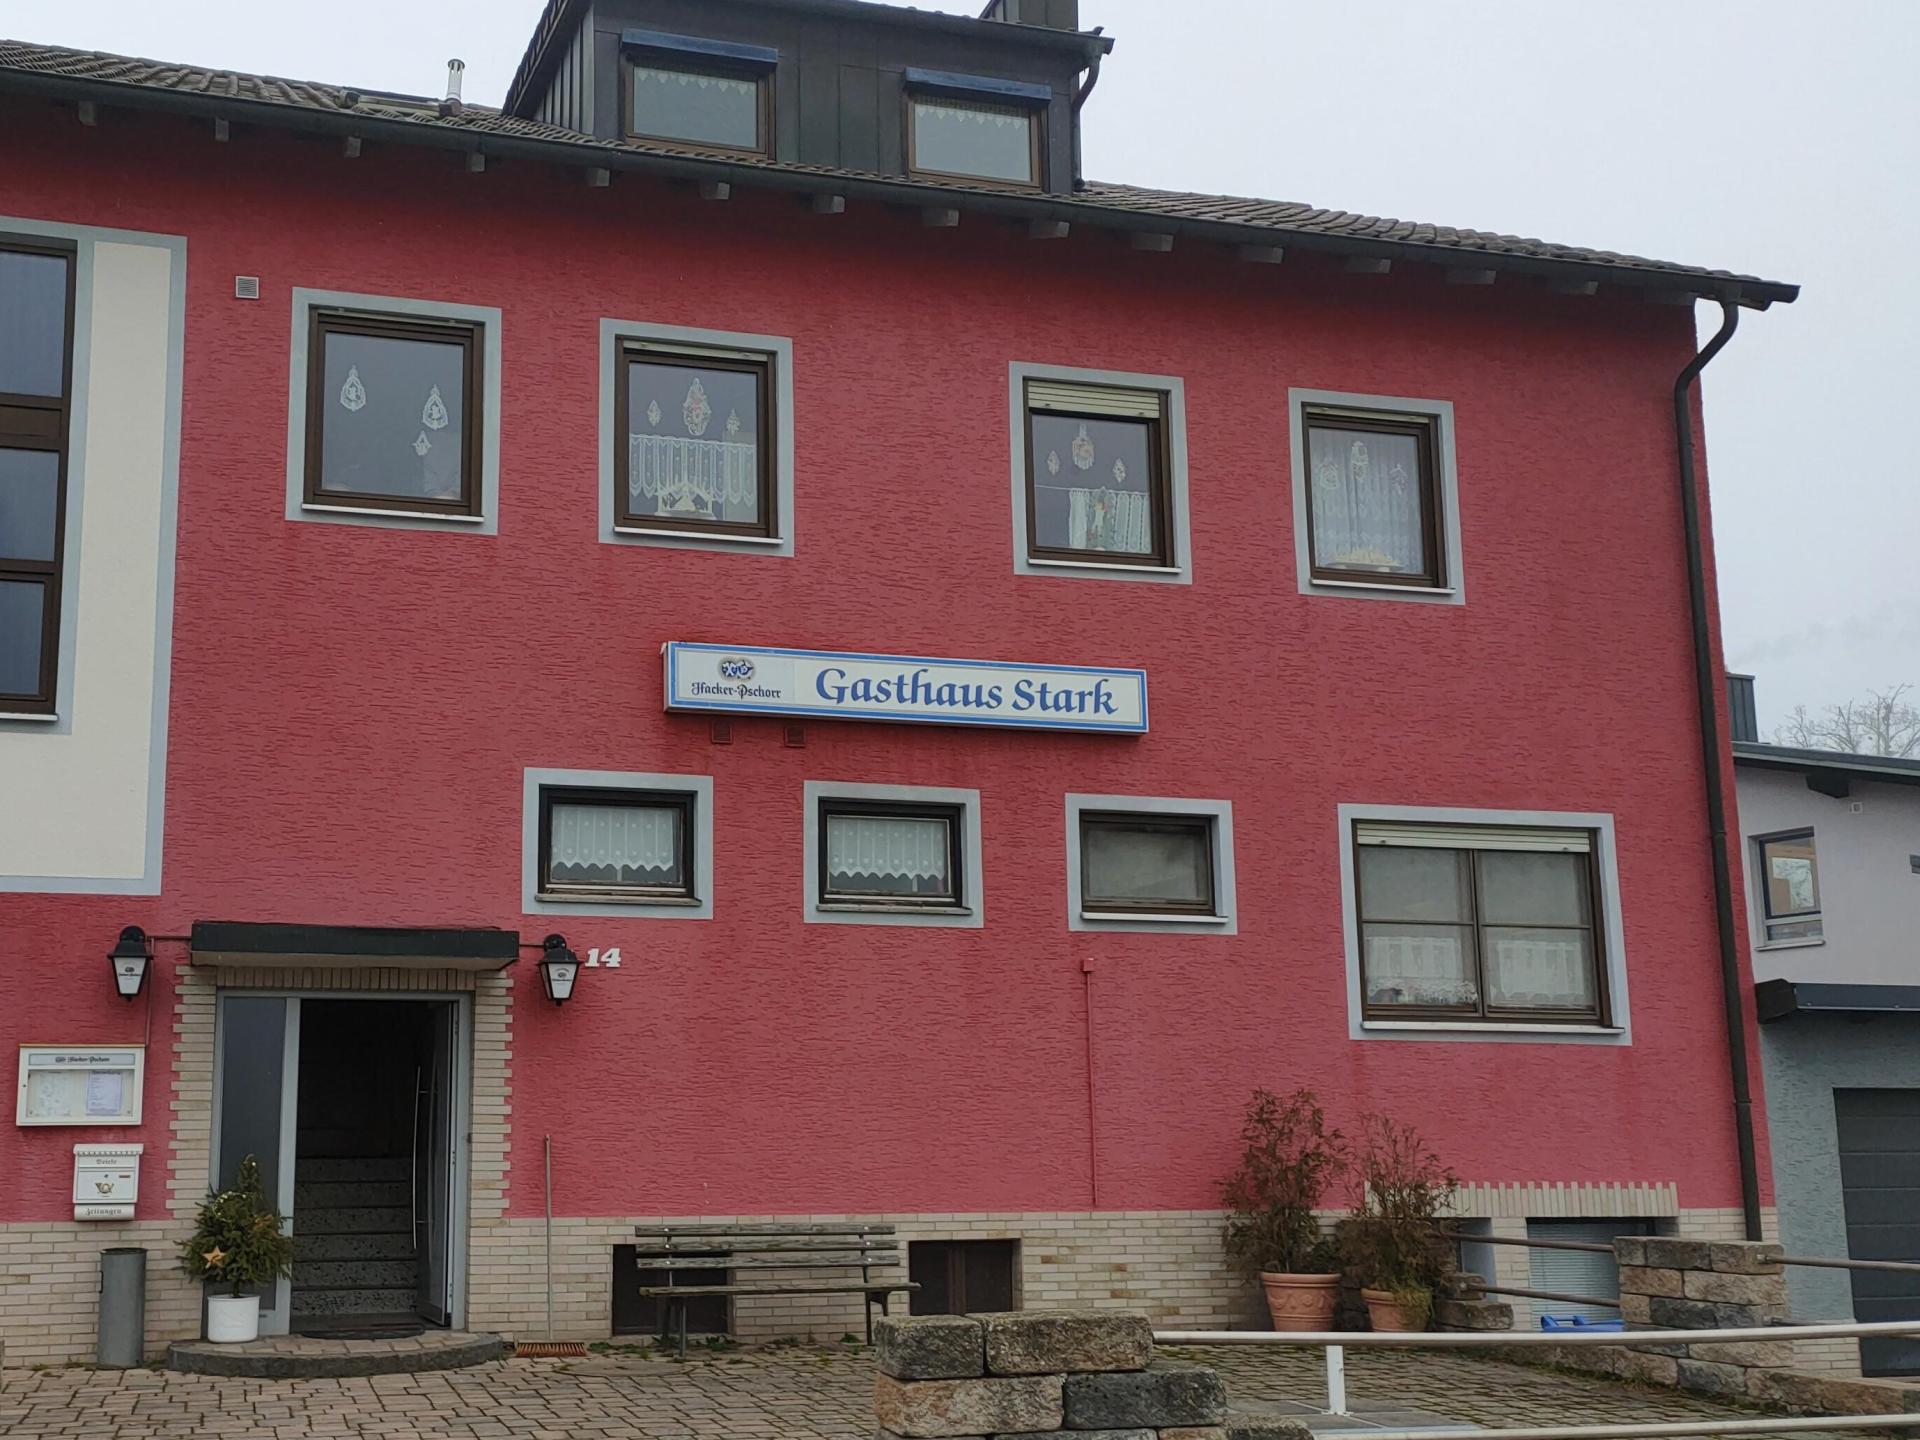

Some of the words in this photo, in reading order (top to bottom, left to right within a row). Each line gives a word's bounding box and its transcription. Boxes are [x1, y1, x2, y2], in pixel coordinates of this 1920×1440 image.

[691, 682, 782, 700] Hacker-Pschorr
[816, 667, 1003, 710] Gasthaus
[1011, 679, 1118, 715] Stark
[585, 948, 622, 967] 14
